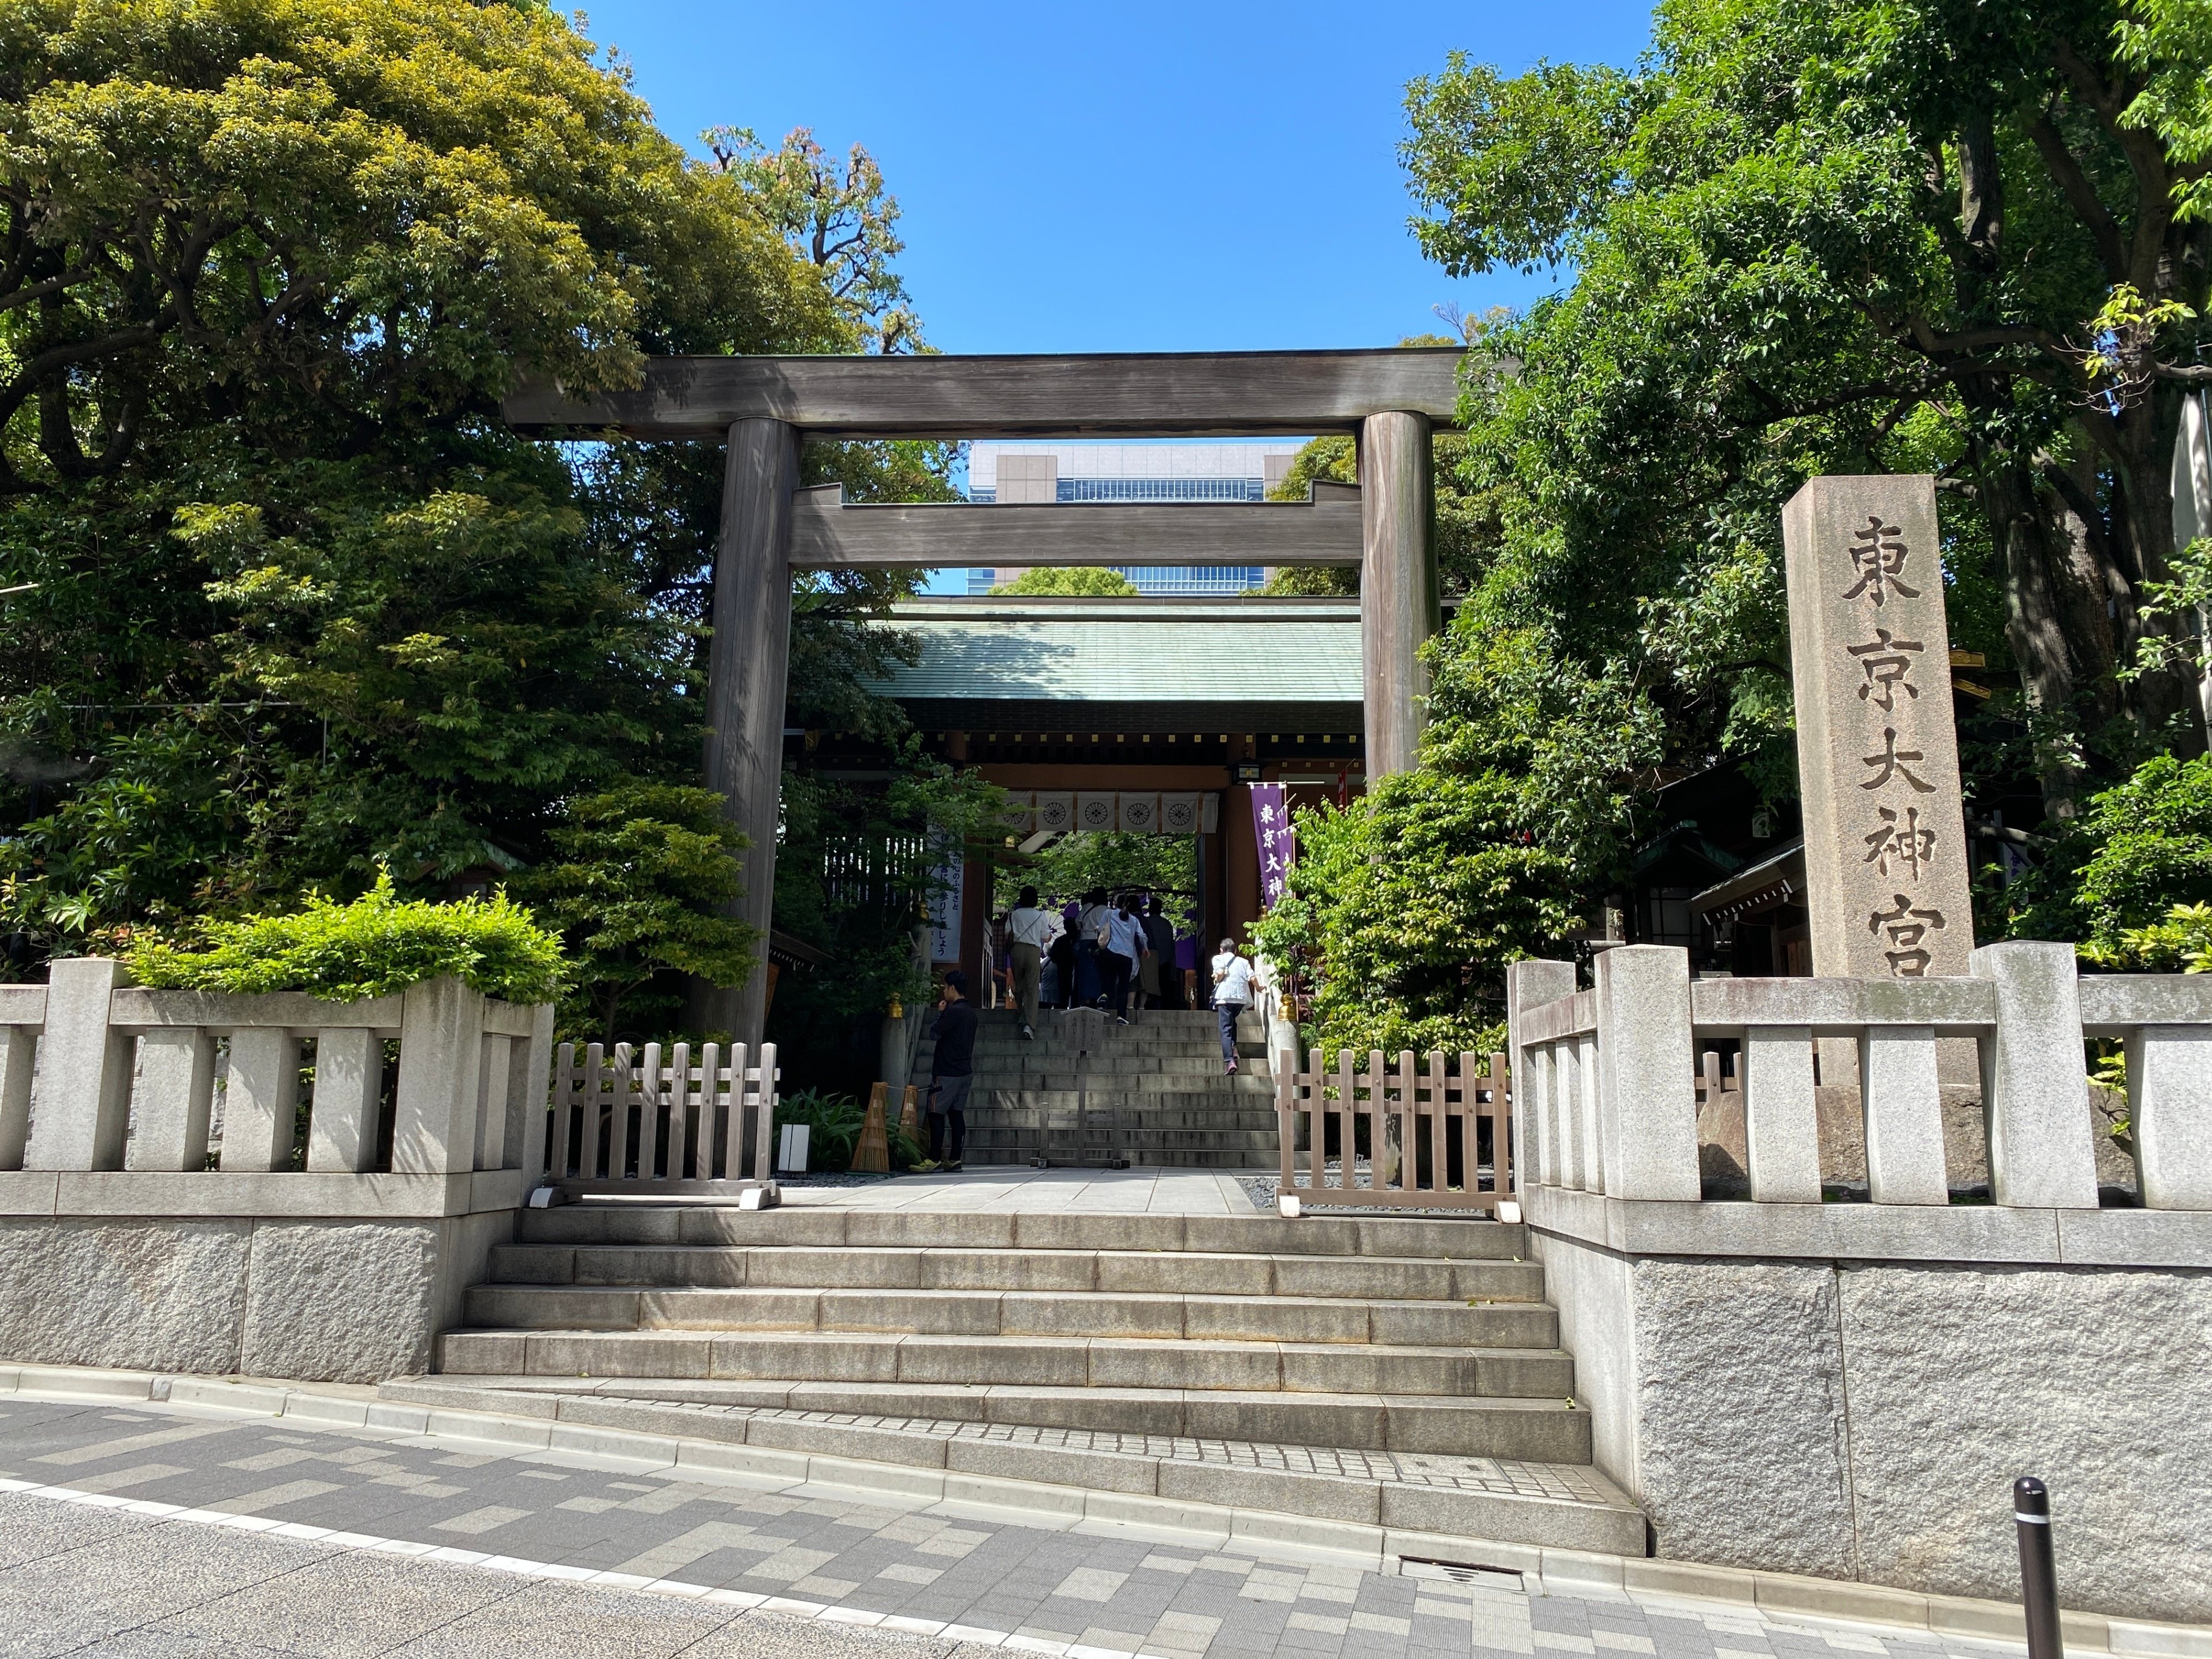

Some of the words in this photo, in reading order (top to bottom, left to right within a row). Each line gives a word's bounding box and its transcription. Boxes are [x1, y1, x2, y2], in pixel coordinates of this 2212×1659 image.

[1842, 515, 1946, 977] 東京大神宮
